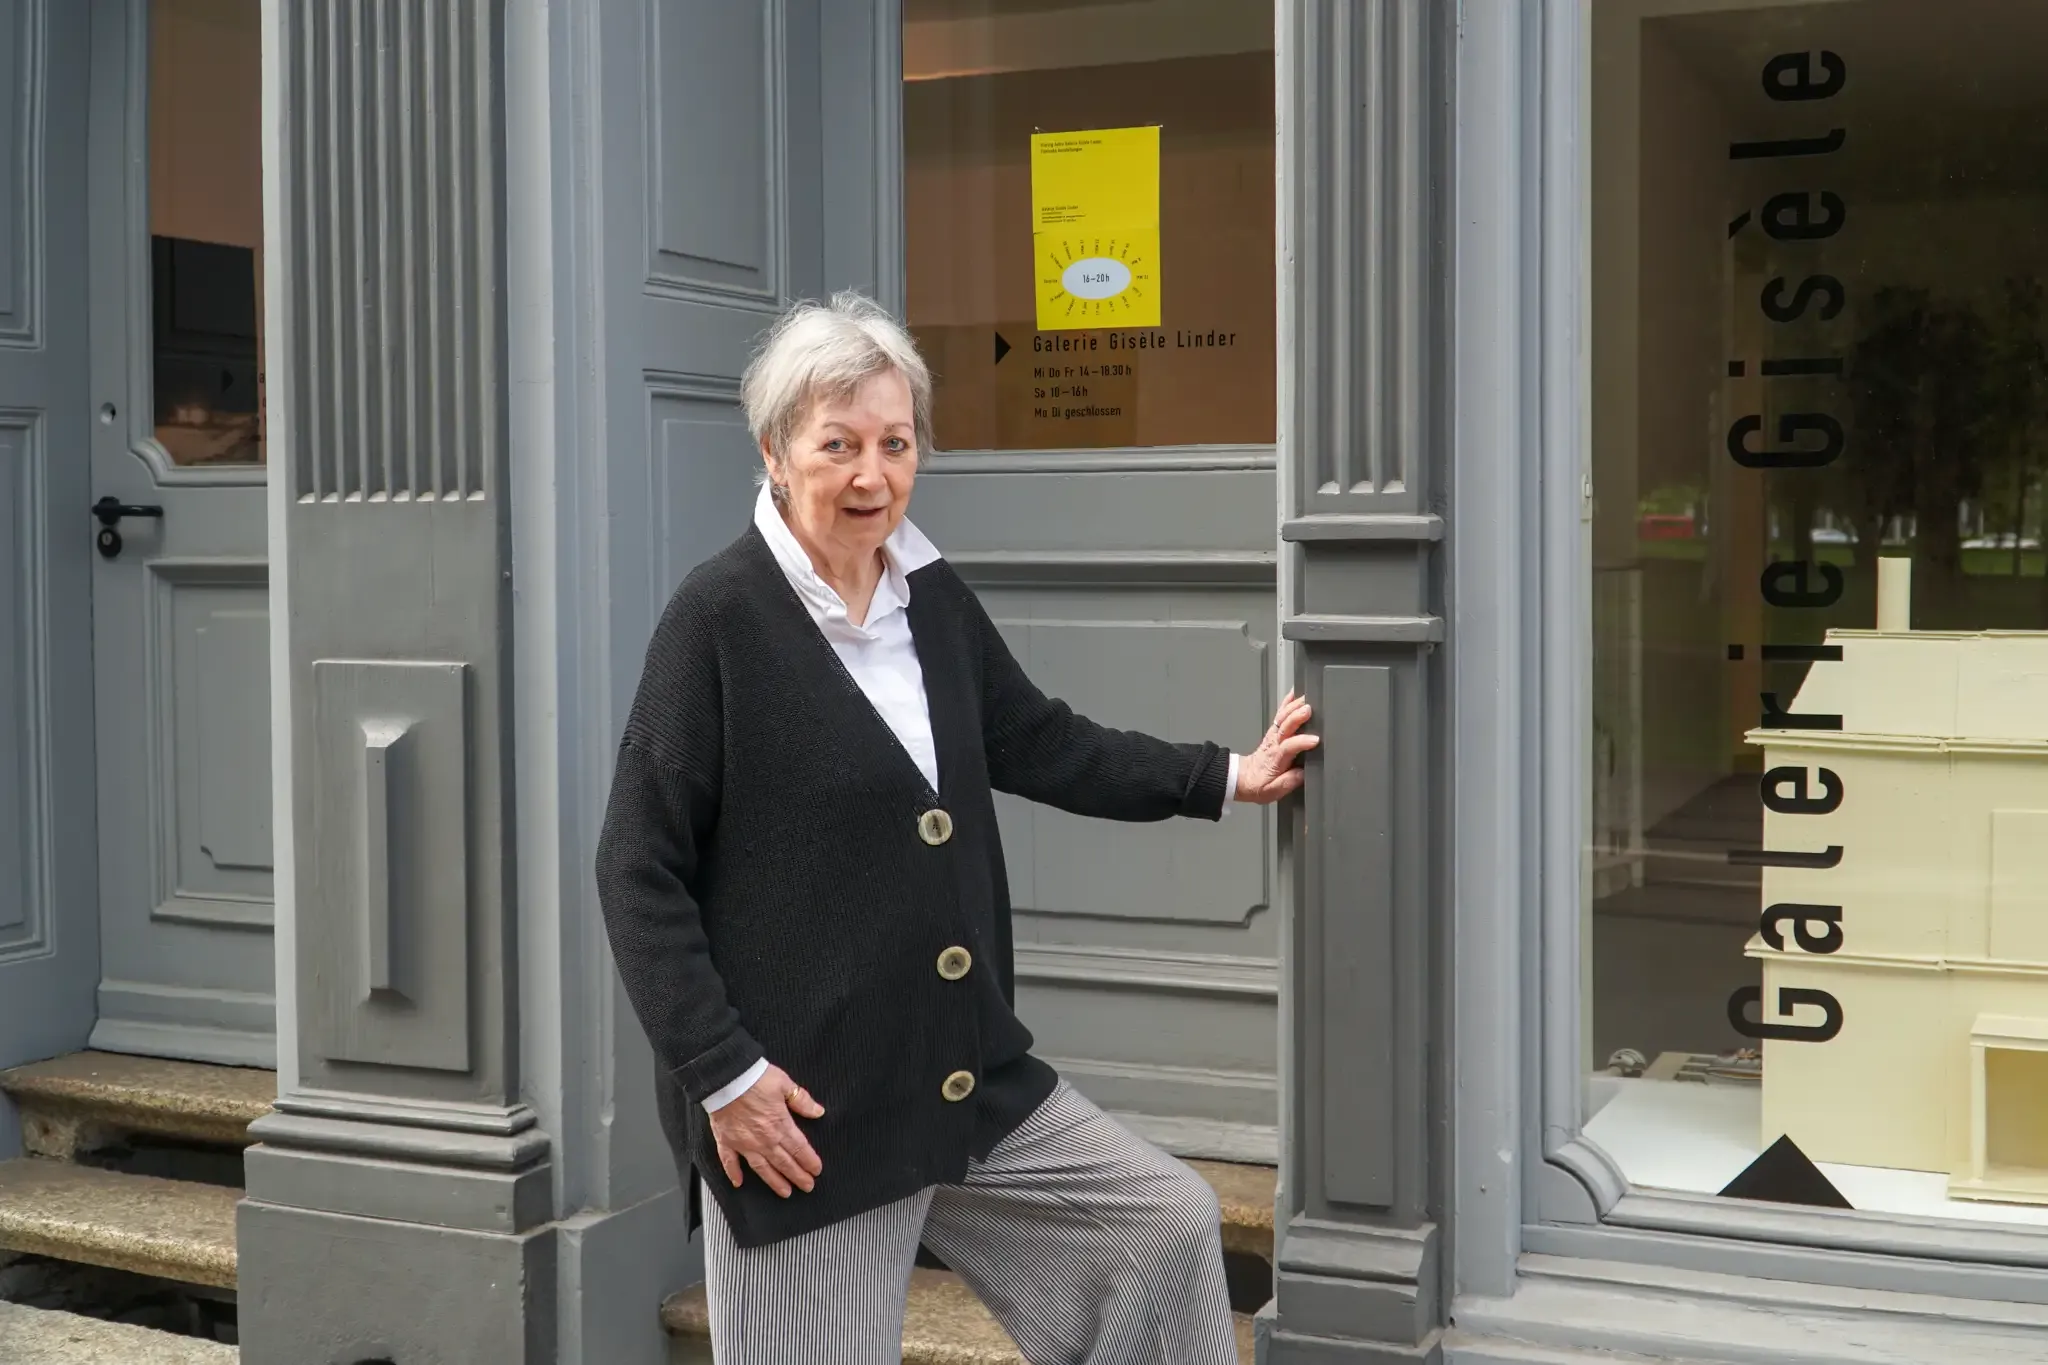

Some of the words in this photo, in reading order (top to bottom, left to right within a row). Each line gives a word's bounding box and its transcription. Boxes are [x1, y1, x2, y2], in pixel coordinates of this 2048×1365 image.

[1727, 49, 1847, 469] Gisèle
[1033, 333, 1098, 353] Galerie
[1109, 331, 1166, 351] Gisèle
[1177, 329, 1237, 348] Linder
[1034, 367, 1045, 378] Mi
[1049, 367, 1060, 378] Do
[1065, 366, 1075, 378] Fr
[1034, 387, 1045, 398] Sa
[1034, 407, 1048, 418] Mo
[1052, 406, 1061, 418] Di
[1065, 404, 1122, 420] geschlossen
[1727, 558, 1845, 1043] Galerie
